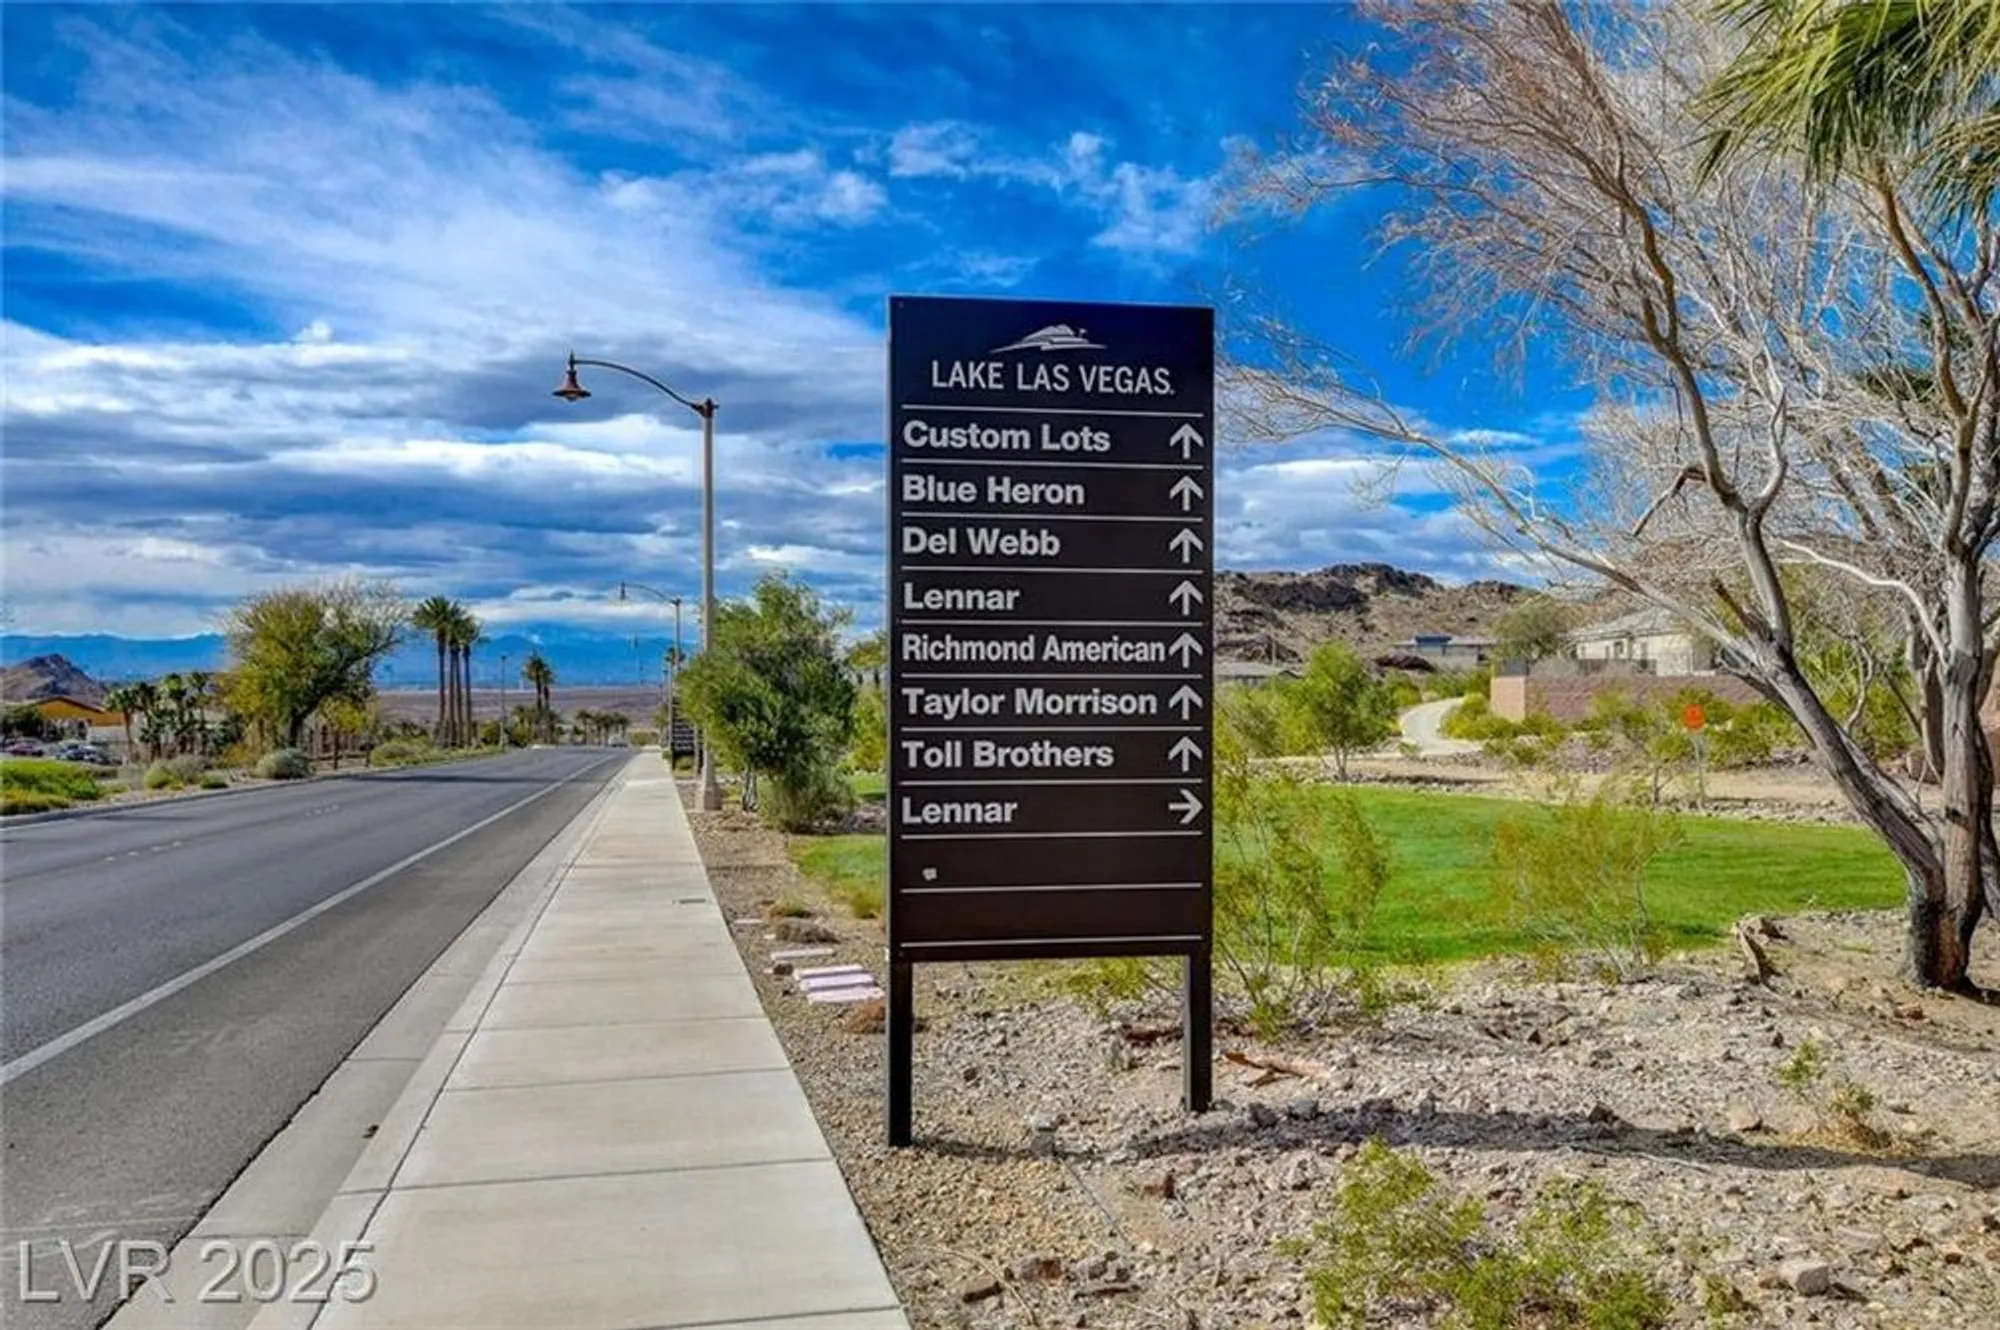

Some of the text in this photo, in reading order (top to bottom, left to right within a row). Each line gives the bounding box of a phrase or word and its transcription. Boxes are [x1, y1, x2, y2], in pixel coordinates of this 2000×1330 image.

[932, 361, 1004, 390] LAKE
[1017, 364, 1070, 391] LAS
[903, 420, 1110, 452] Custom Lots
[903, 475, 1085, 504] Blue Heron
[903, 527, 1061, 556] Del Webb
[904, 583, 1020, 610] Lennar
[903, 634, 1166, 662] Richmond American
[902, 688, 1158, 721] Taylor Morrison
[902, 740, 1115, 768] Toll Brothers
[903, 798, 1018, 824] Lennar
